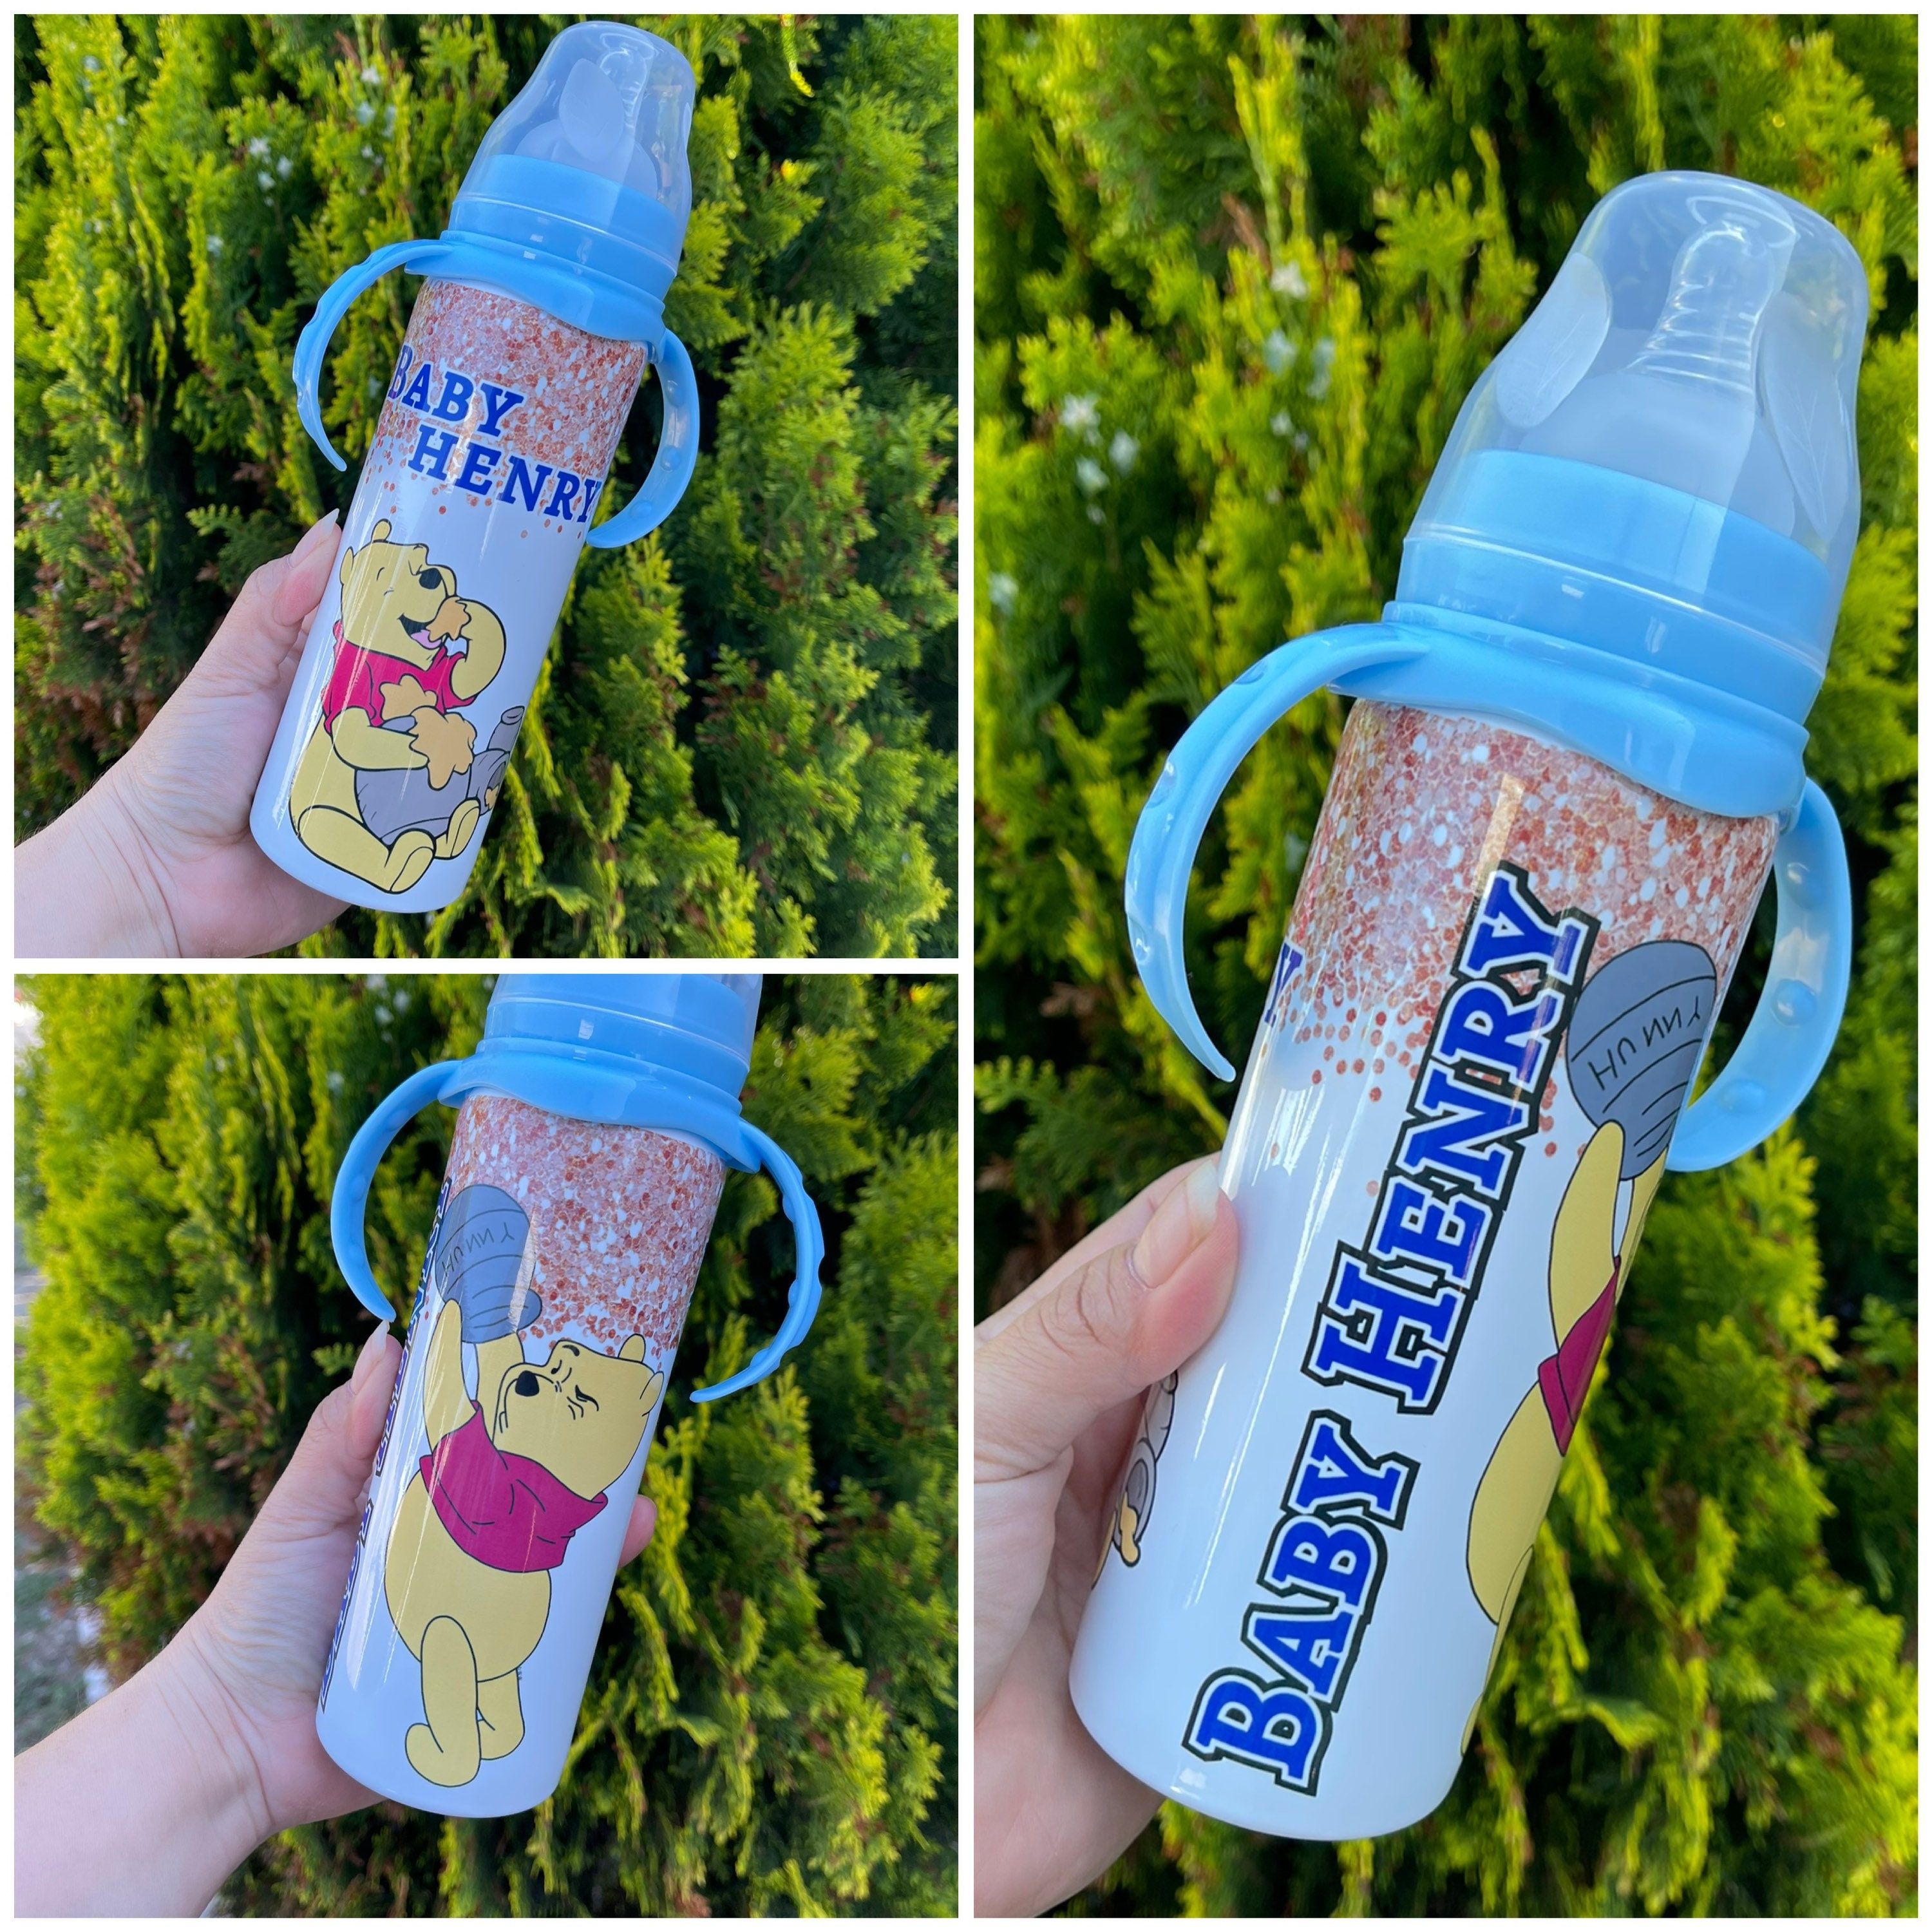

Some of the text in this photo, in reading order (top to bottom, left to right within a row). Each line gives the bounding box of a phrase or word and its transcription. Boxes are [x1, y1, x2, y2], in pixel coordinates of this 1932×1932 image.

[388, 345, 524, 437] BABY
[407, 424, 603, 523] HENRY
[1182, 860, 1602, 1797] BABY HENRY
